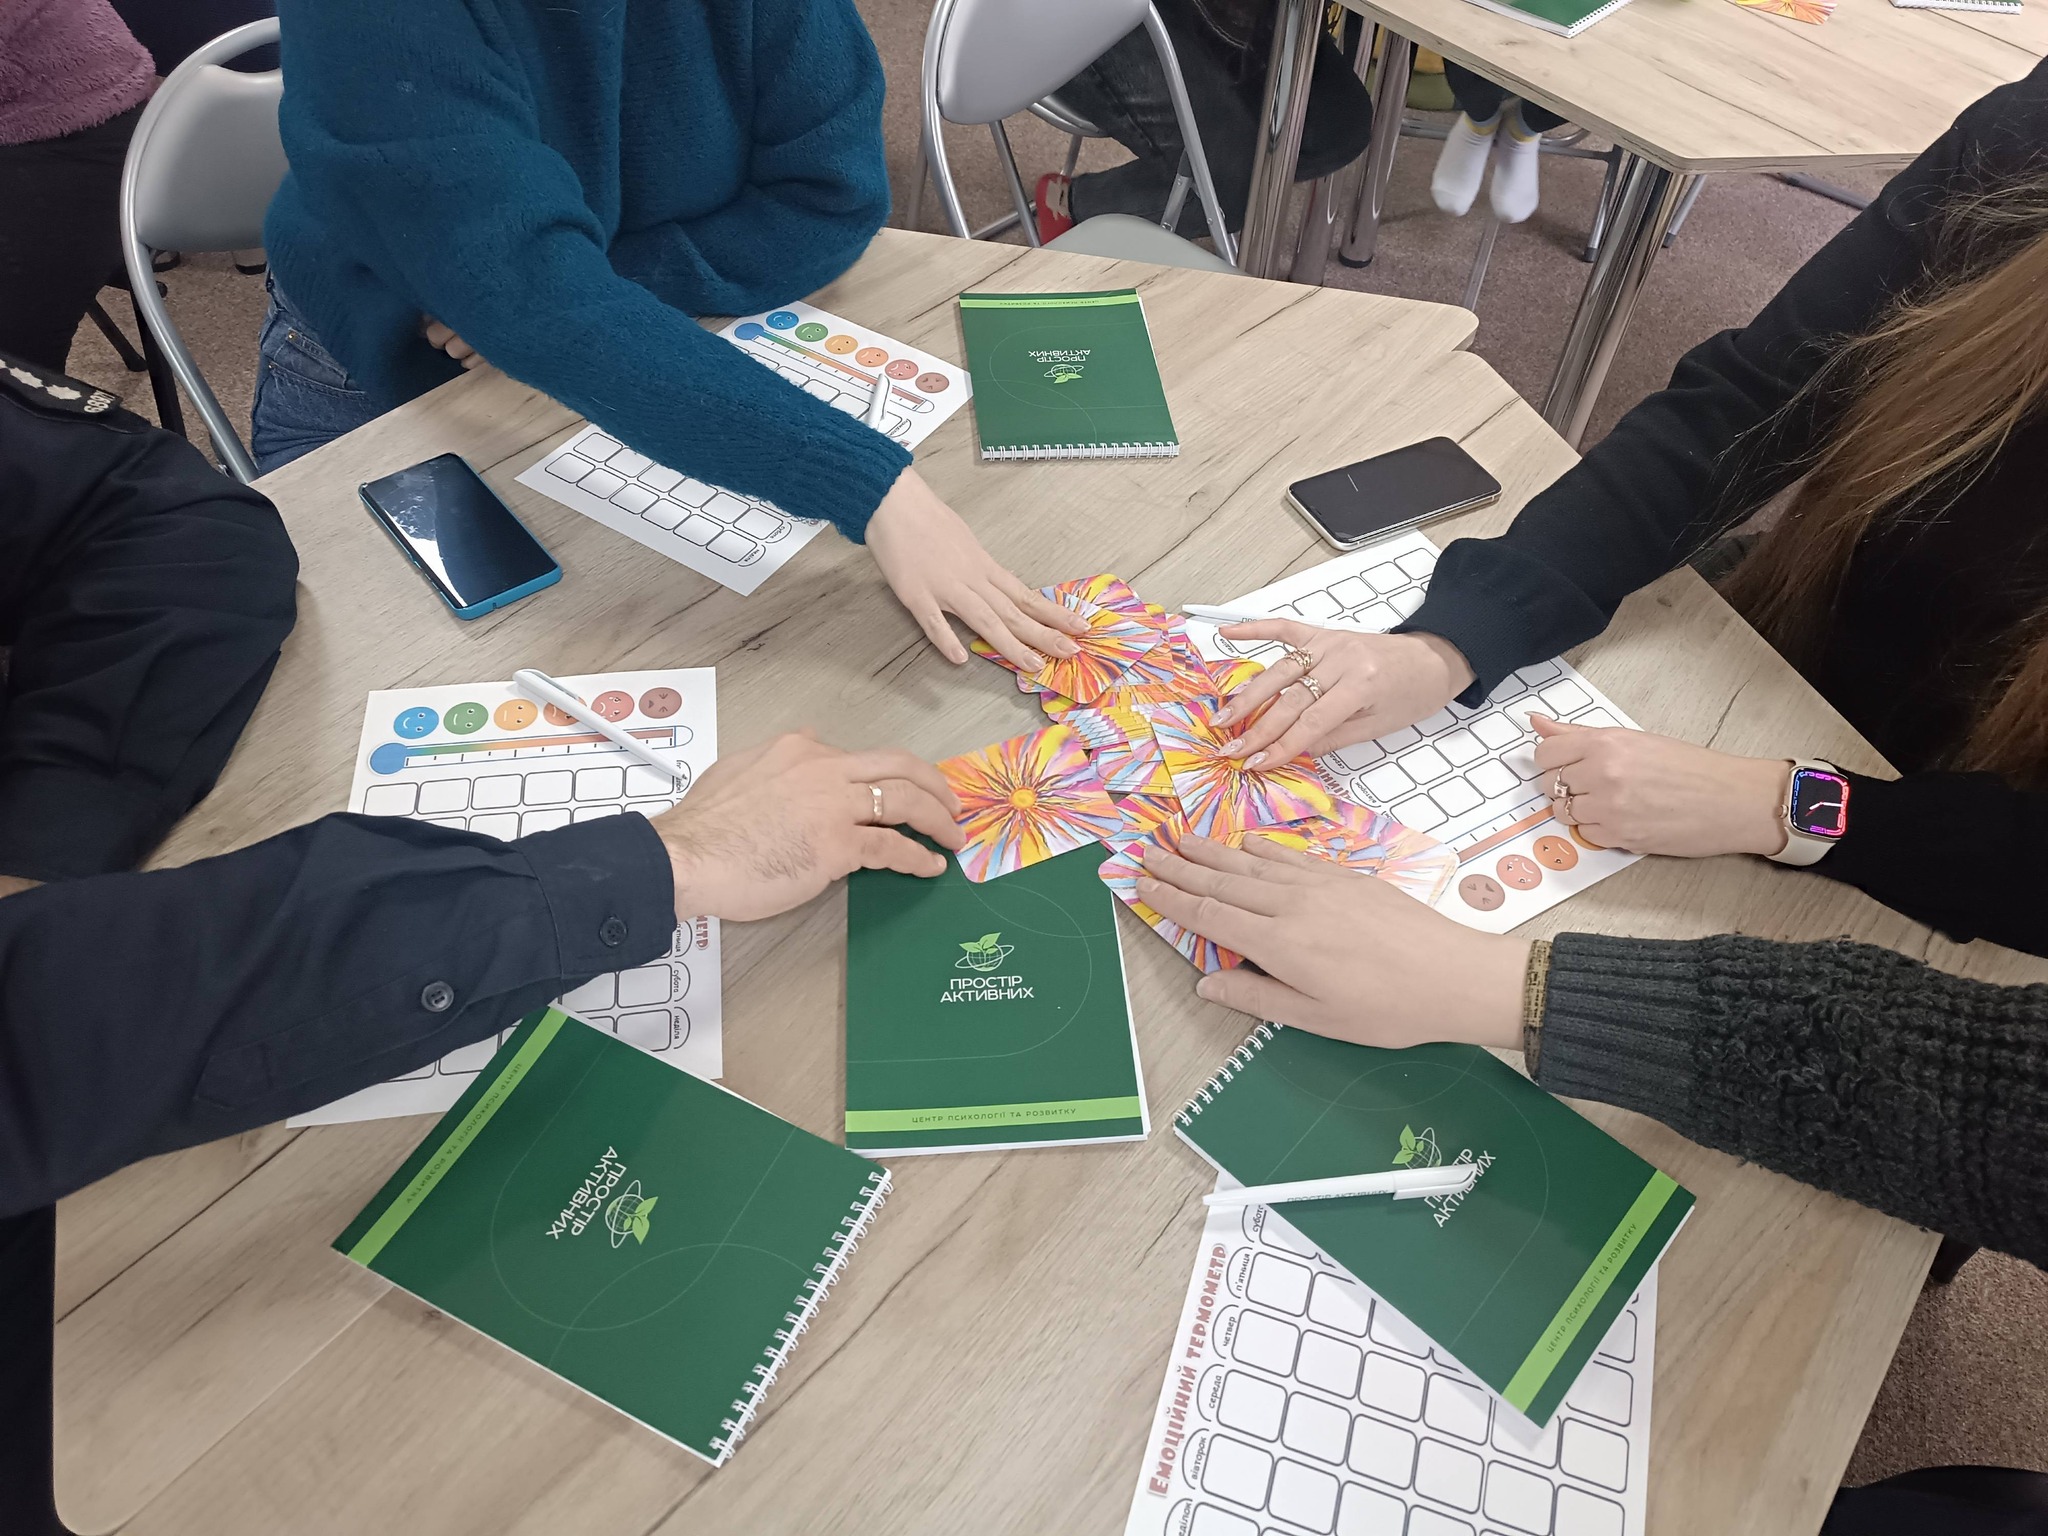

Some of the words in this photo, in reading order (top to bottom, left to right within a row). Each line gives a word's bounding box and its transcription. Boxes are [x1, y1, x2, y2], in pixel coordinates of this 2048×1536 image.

[1028, 349, 1091, 358] АКТИВНИХ
[1036, 355, 1086, 363] ПРОСТІР
[1355, 781, 1377, 804] вівторок
[672, 969, 681, 993] субота
[940, 986, 1035, 1003] АКТИВНИХ
[950, 975, 1023, 990] ПРОСТІР
[501, 1063, 522, 1091] ЦЕНТР
[911, 1114, 944, 1124] ЦЕНТР
[947, 1112, 1007, 1121] ПСИХОЛОГІЇ
[1010, 1110, 1022, 1118] ТА
[1025, 1108, 1077, 1118] РОЗВИТКУ
[445, 1146, 455, 1156] ТА
[546, 1146, 618, 1240] АКТИВНИХ
[571, 1162, 627, 1237] ПРОСТІР
[1235, 1253, 1250, 1292] п'ятниця
[1546, 1325, 1567, 1354] ЦЕНТР
[1565, 1275, 1601, 1325] ПСИХОЛОГІЇ
[1599, 1265, 1609, 1276] ТА
[1606, 1223, 1637, 1264] РОЗВИТКУ
[1223, 1315, 1236, 1347] четвер
[1149, 1366, 1198, 1495] ЕМОЦІЙНИЙ
[1186, 1245, 1228, 1359] ТЕРМОМЕТР
[1208, 1374, 1222, 1409] середа
[1191, 1436, 1207, 1480] вівторок
